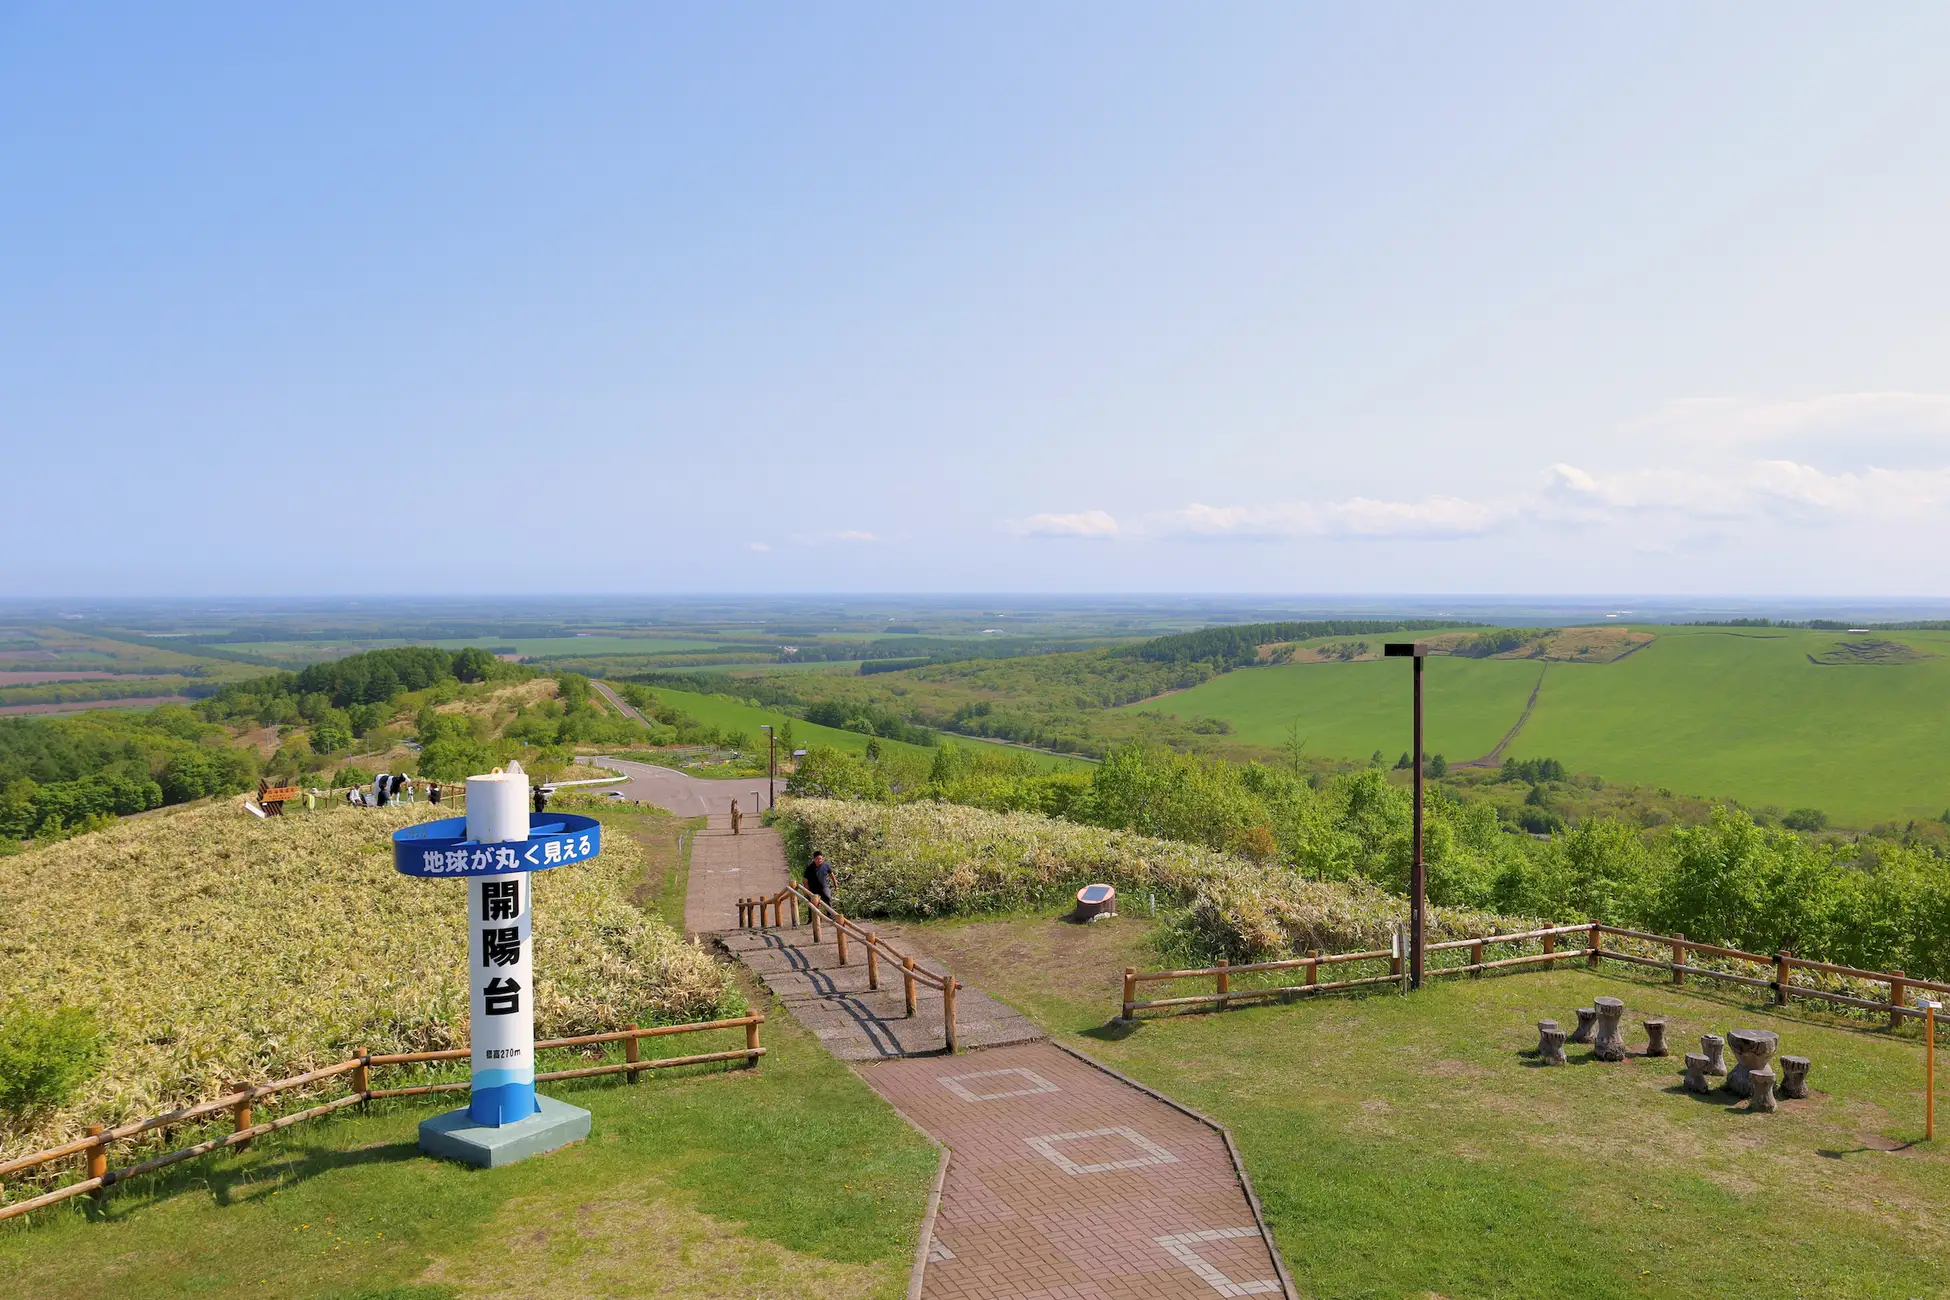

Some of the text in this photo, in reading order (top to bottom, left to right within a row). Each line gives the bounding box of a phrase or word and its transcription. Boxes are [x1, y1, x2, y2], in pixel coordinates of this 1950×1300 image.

[422, 835, 591, 873] 地球が丸く見える
[482, 879, 521, 1016] 開陽台
